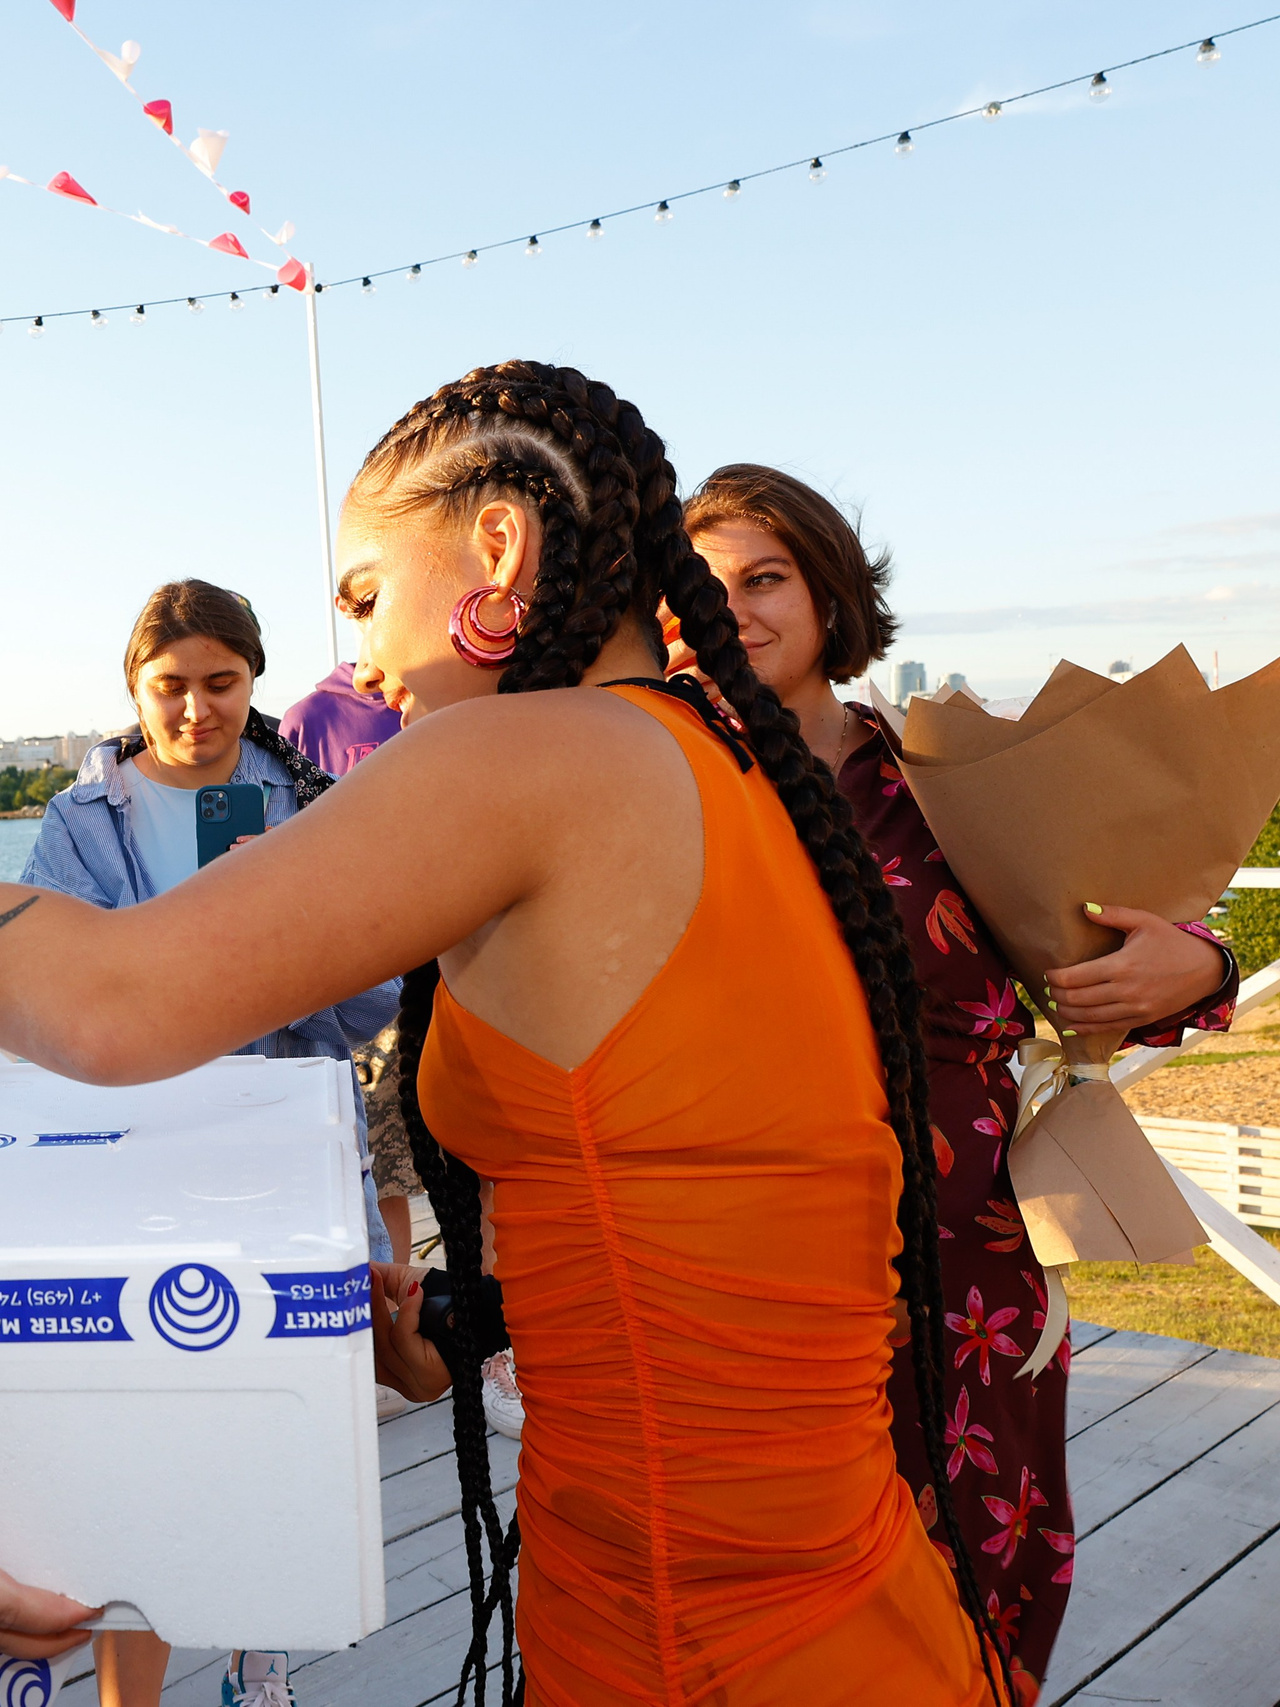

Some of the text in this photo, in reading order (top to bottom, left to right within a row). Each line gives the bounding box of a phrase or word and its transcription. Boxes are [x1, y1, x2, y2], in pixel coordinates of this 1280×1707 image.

[27, 1286, 74, 1307] (495)
[80, 1289, 102, 1305] +7
[289, 1274, 372, 1301] 743-11-63
[29, 1315, 115, 1335] OYSTER
[283, 1302, 372, 1330] MARKET
